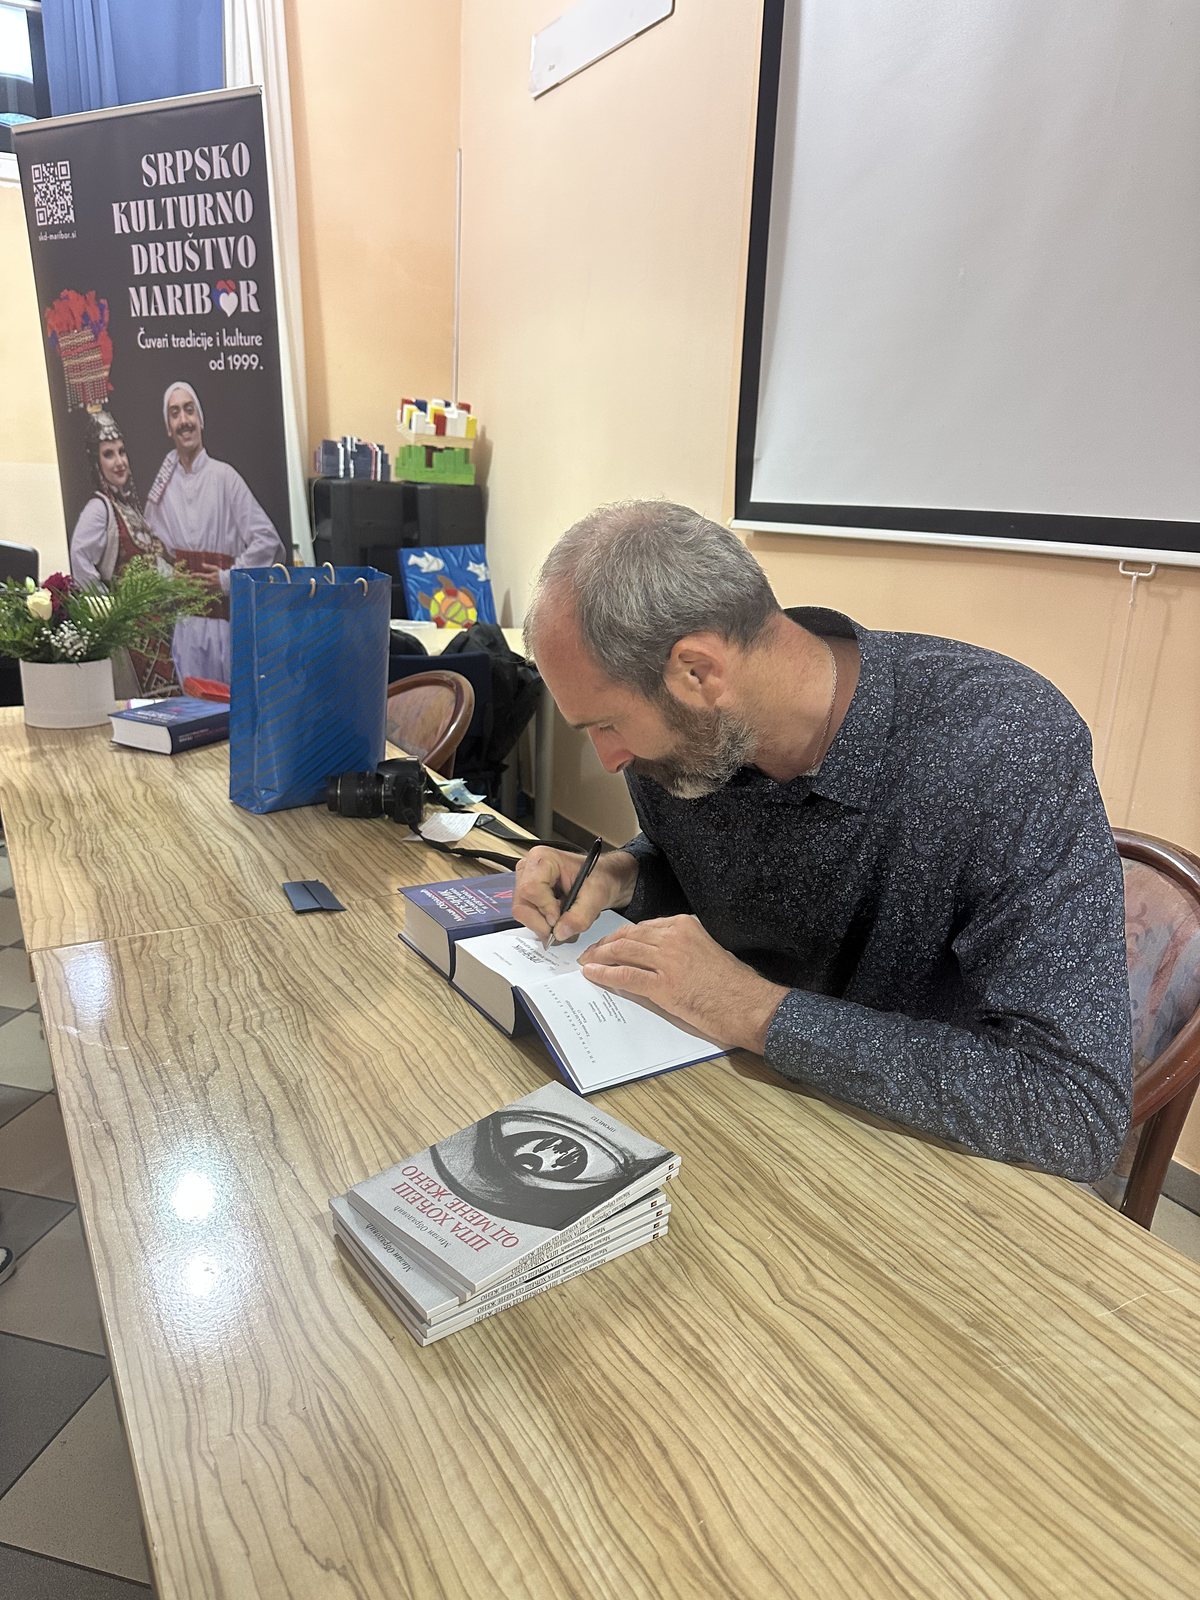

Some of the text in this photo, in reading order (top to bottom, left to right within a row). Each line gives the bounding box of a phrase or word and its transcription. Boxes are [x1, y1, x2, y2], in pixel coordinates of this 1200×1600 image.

[141, 142, 250, 188] SRPSKO
[112, 189, 254, 234] KULTURNO
[131, 233, 257, 276] DRUŠTVO
[137, 327, 263, 352] Čuvari tradicije i kulture
[209, 353, 264, 371] od 1999.
[391, 1181, 492, 1252] ШТА ХОЋЕШ
[393, 1205, 452, 1248] Милан Обрадовић
[401, 1165, 519, 1248] ОД МЕНЕ ЖЕНО
[365, 1222, 414, 1273] Милан Обрадовић
